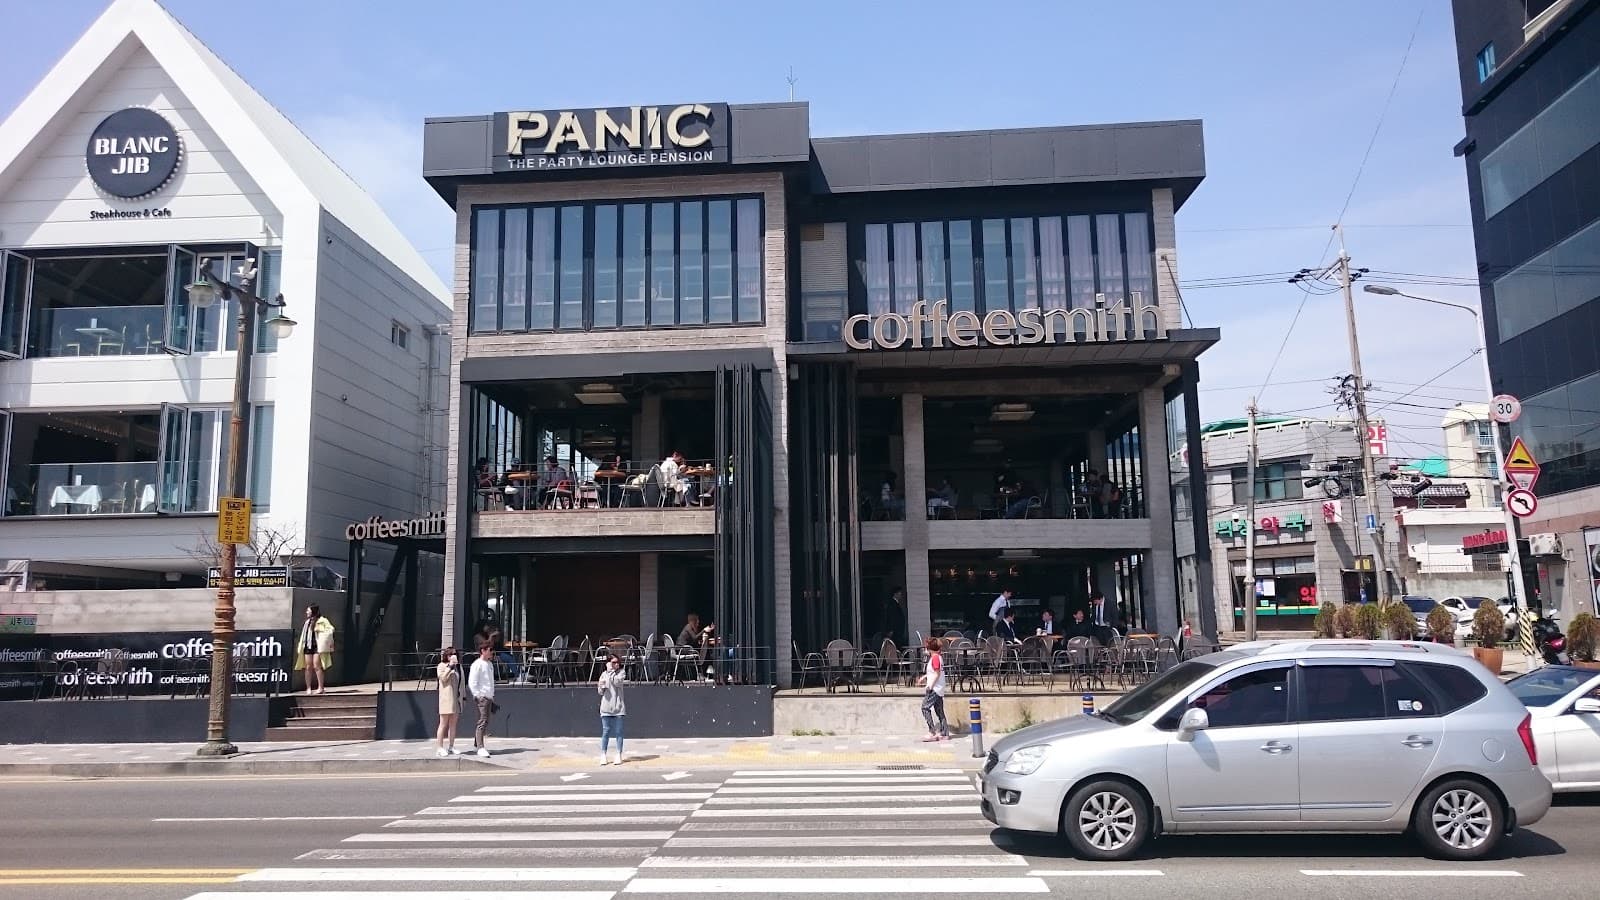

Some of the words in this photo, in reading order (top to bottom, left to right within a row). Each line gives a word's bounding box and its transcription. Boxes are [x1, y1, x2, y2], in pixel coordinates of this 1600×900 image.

[505, 104, 712, 155] PANIC
[95, 136, 169, 155] BLANC
[111, 156, 150, 175] JIB
[507, 158, 535, 169] THE
[538, 156, 585, 168] PARTY
[588, 153, 647, 167] LOUNGE
[650, 151, 713, 163] PENSION
[90, 209, 142, 219] Steakhouse
[143, 208, 150, 217] &
[152, 207, 173, 217] Cafe
[843, 292, 1168, 351] coffeesmith
[1497, 403, 1512, 415] 30
[345, 509, 448, 541] coffeesmith
[243, 569, 259, 578] JIB
[162, 636, 282, 659] coffemith
